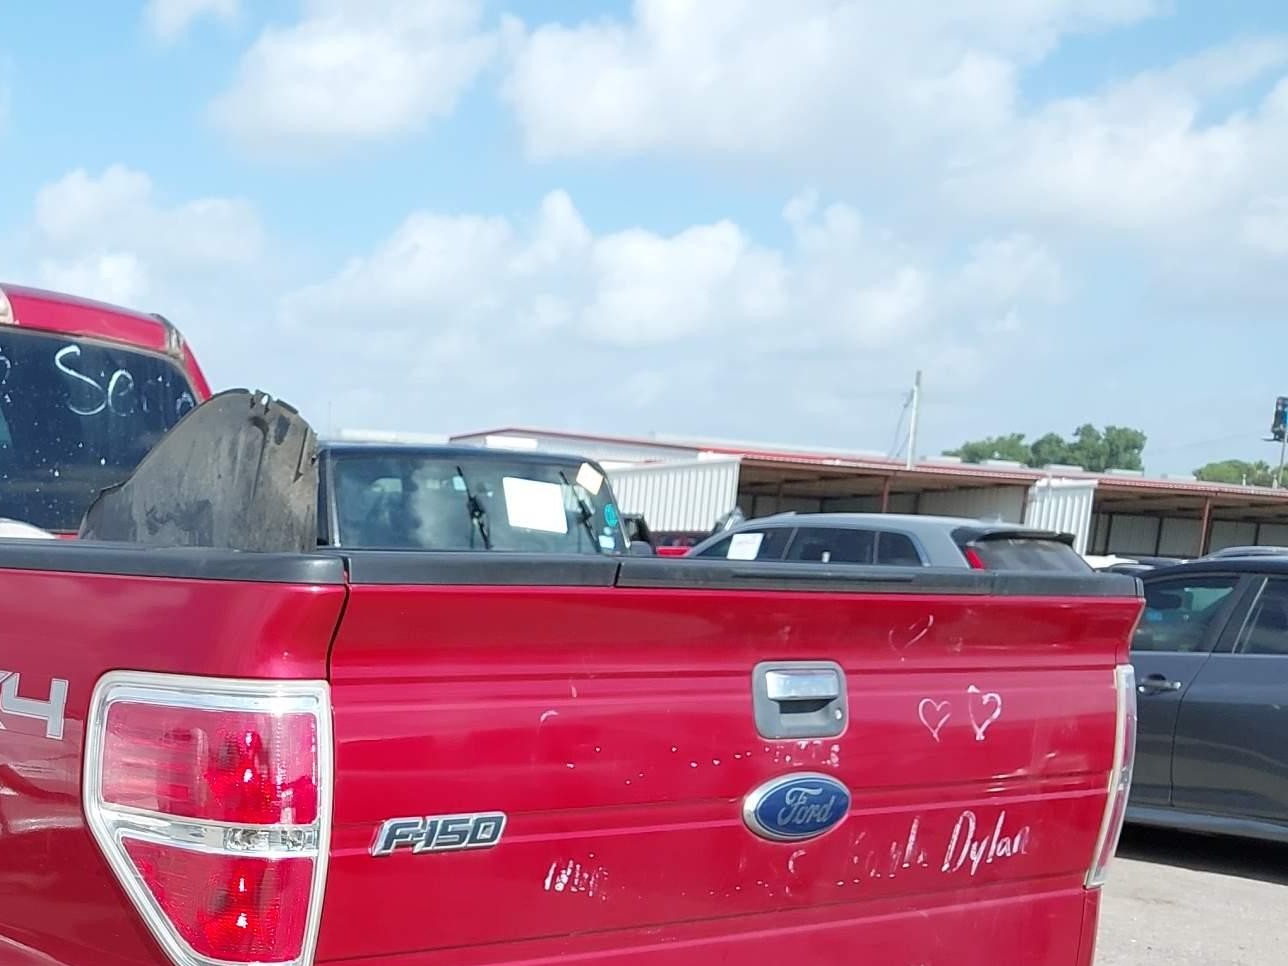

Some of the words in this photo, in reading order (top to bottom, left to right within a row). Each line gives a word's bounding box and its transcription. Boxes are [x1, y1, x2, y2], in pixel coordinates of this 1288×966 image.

[777, 787, 836, 826] Ford
[369, 811, 508, 858] F-150
[941, 810, 1031, 876] Dylan
